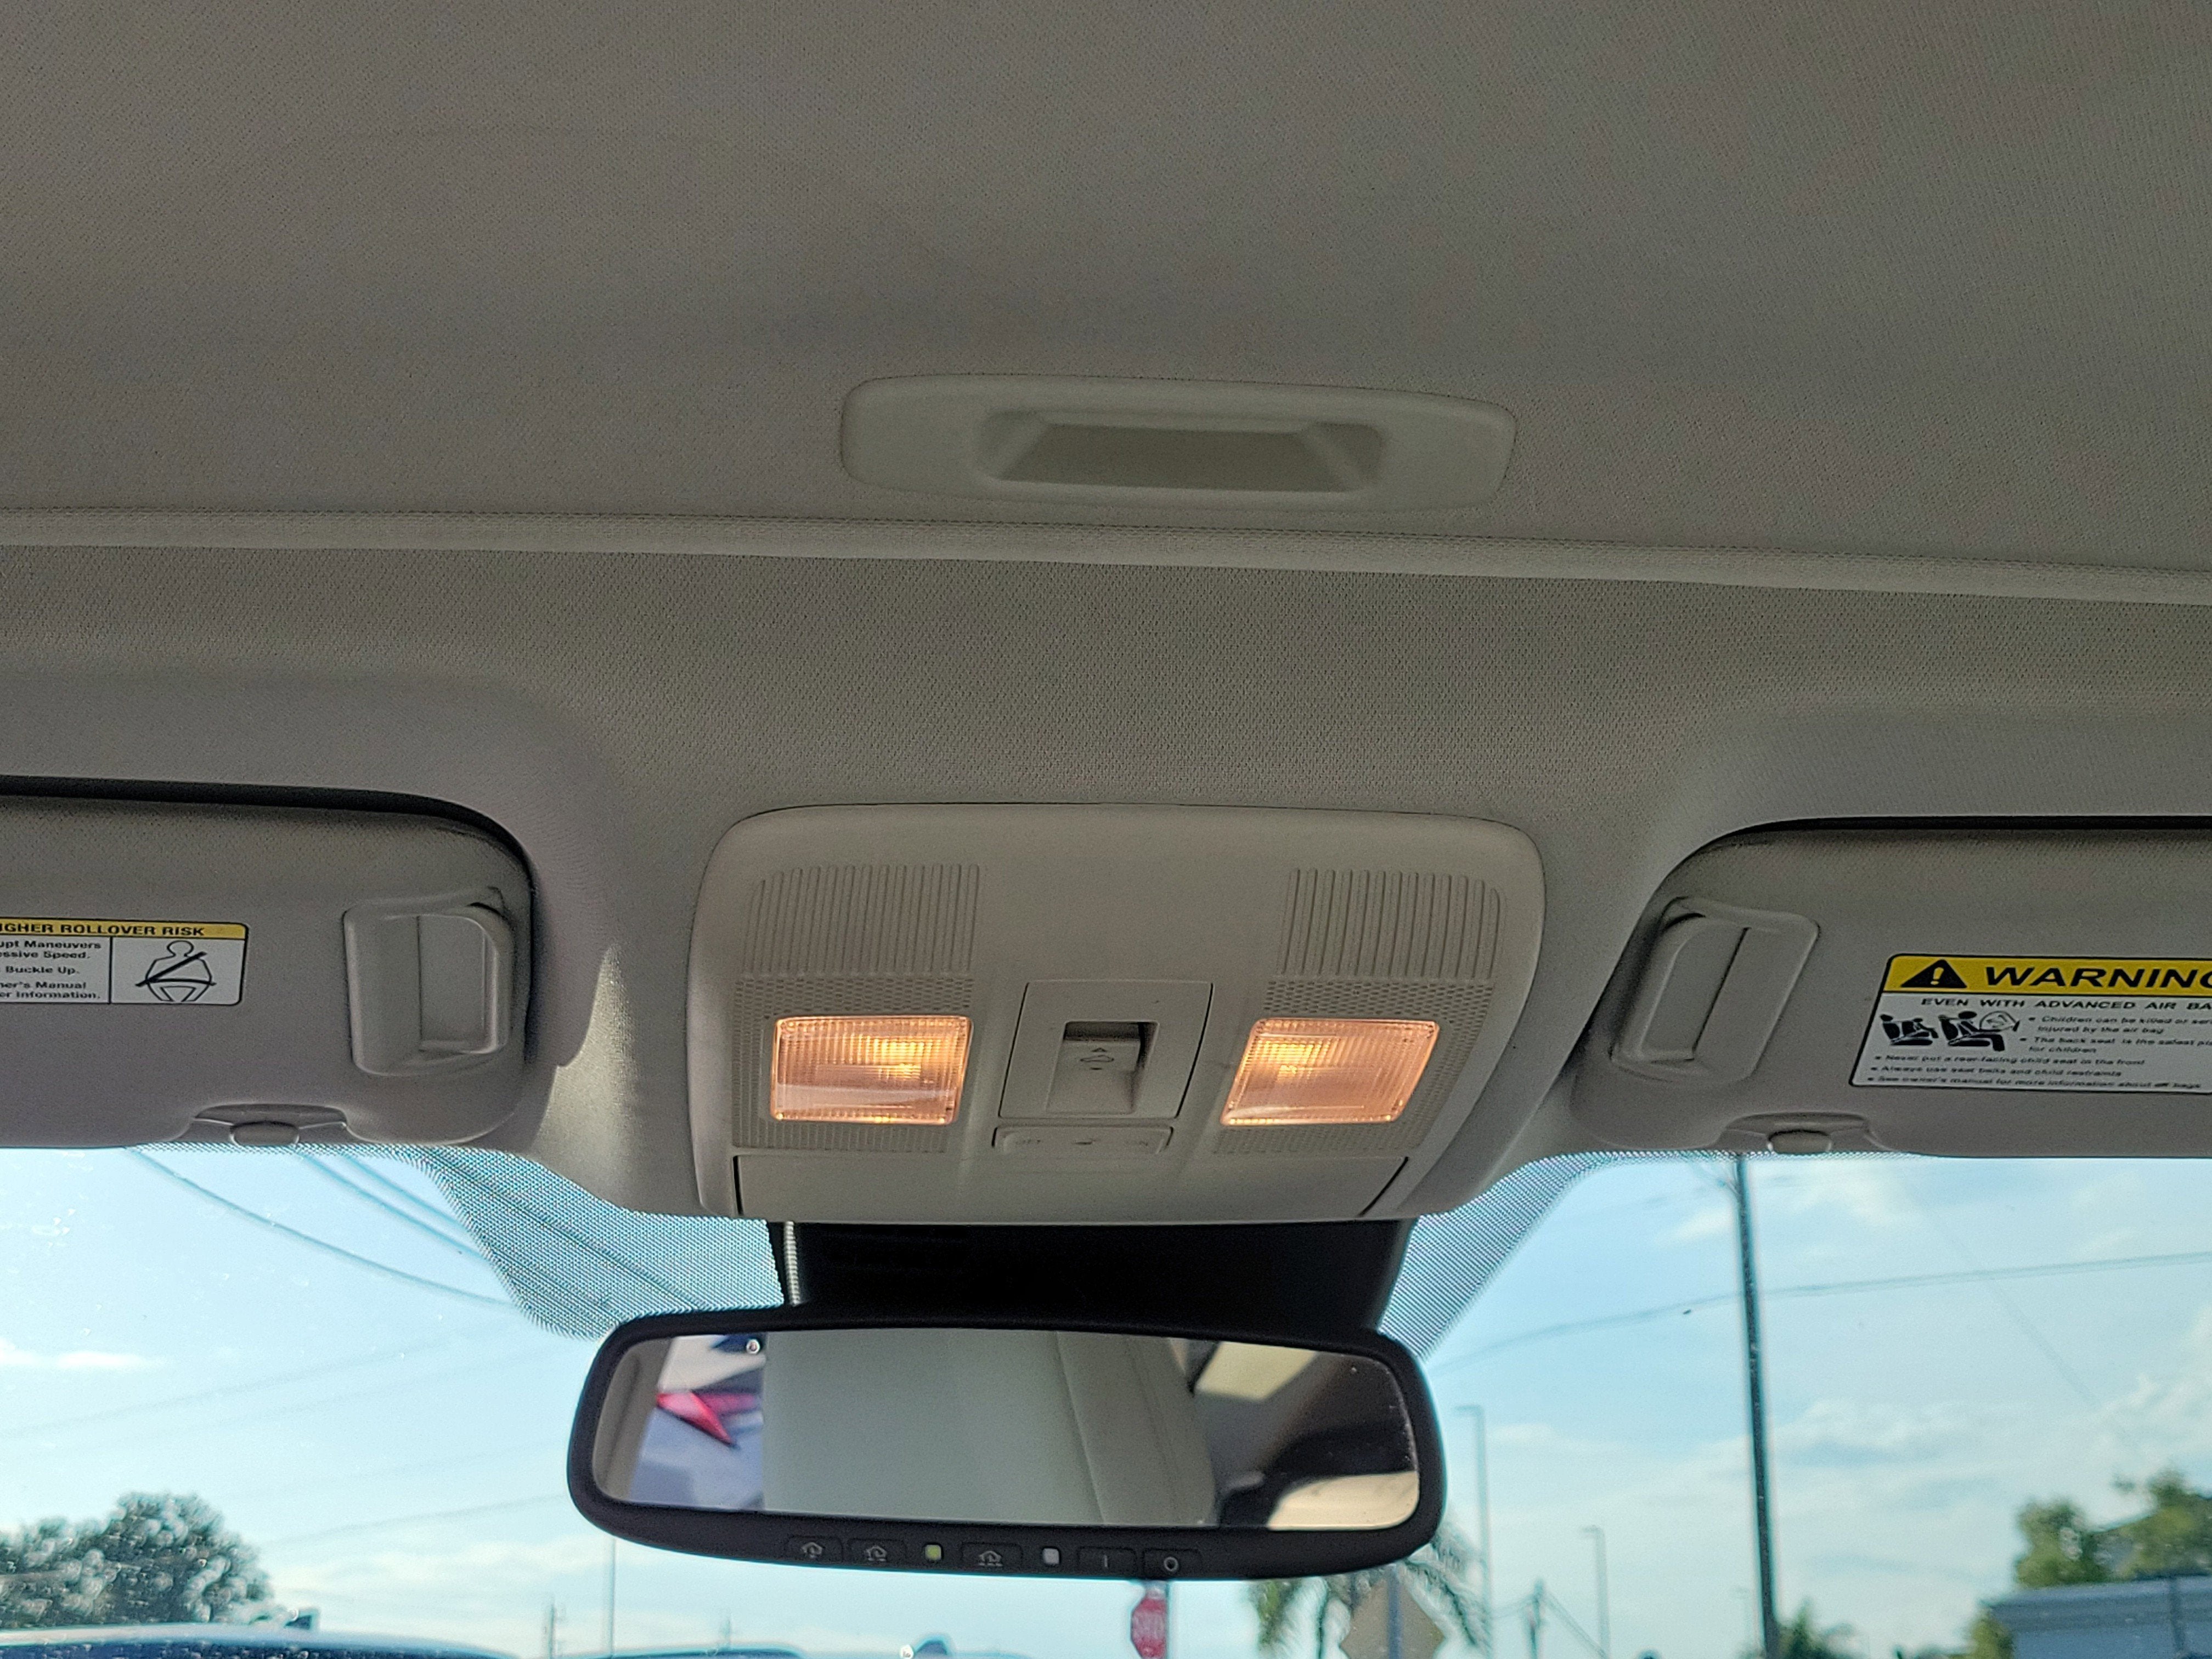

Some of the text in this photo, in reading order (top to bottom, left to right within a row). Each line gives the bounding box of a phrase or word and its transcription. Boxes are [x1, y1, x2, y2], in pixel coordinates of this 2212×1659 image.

[60, 924, 156, 935] ROLLOVER
[162, 927, 205, 936] RISK
[24, 940, 101, 949] Maneuvers
[43, 951, 91, 959] Speed.
[58, 966, 80, 975] Up.
[1921, 998, 1969, 1007] EVEN
[1980, 999, 2026, 1008] WITH
[2034, 1000, 2136, 1009] ADVANCED
[2041, 1015, 2092, 1023] Children
